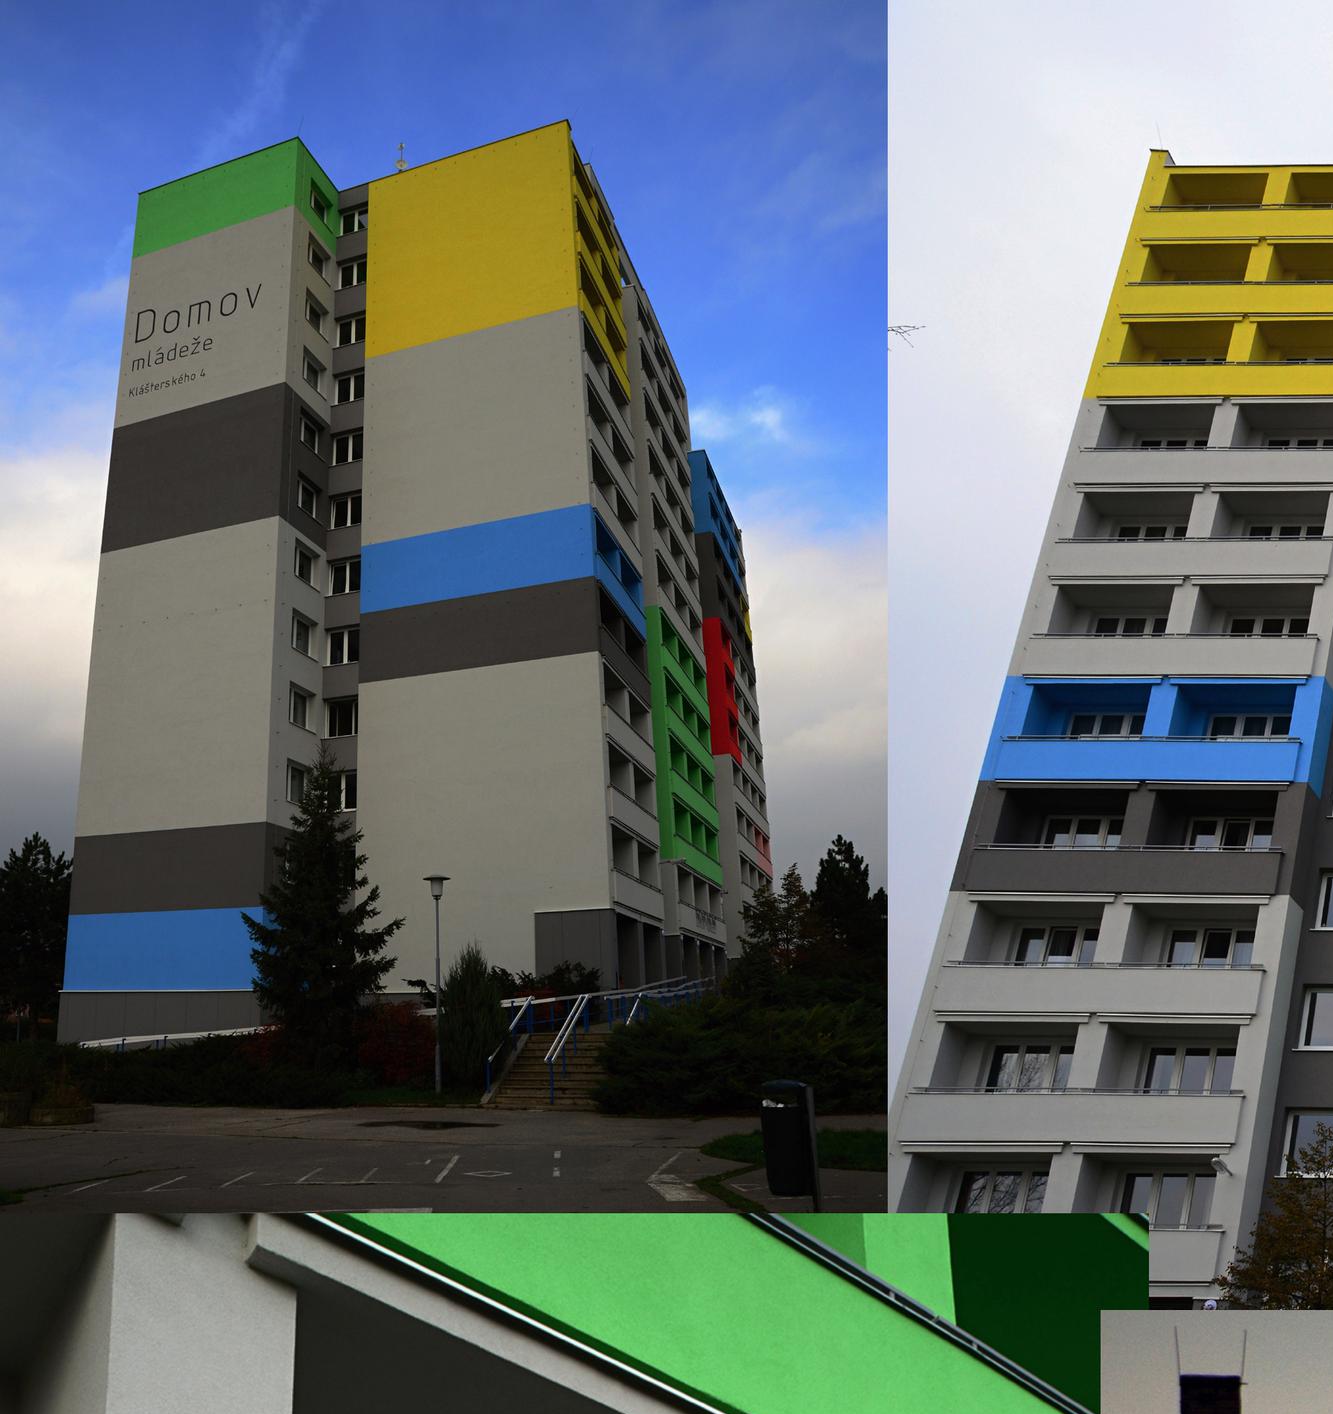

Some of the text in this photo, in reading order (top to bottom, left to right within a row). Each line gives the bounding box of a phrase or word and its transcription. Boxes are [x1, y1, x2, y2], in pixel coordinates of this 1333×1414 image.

[135, 283, 262, 344] Domov
[131, 336, 214, 372] mládeže
[128, 368, 206, 398] Klášterského 4
